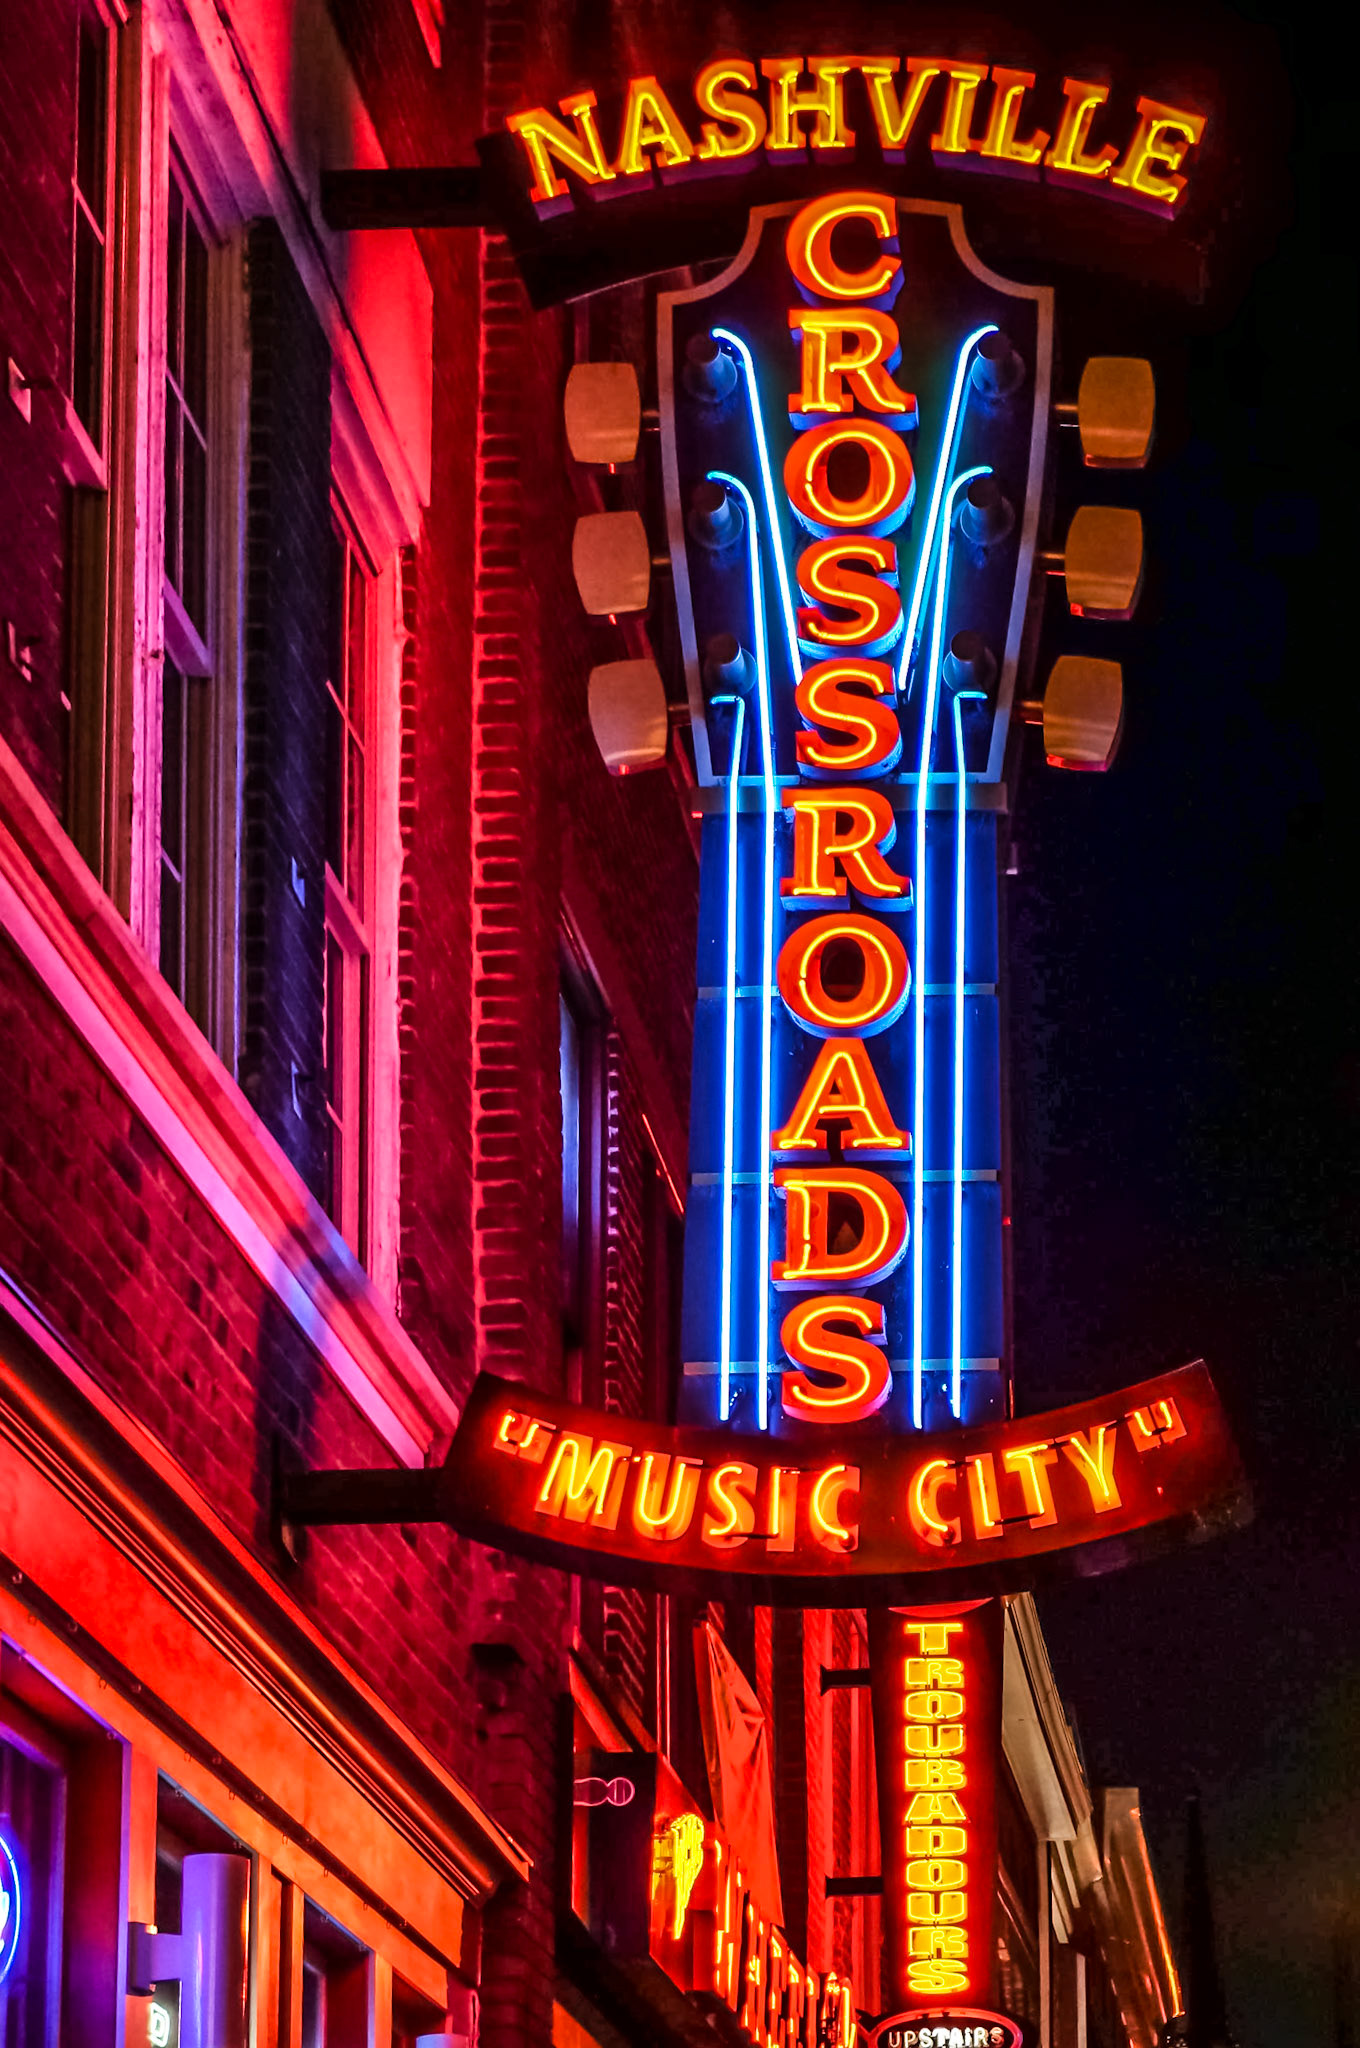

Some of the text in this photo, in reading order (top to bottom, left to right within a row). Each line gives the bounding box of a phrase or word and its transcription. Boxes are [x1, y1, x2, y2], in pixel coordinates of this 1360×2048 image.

[505, 55, 1206, 204] NASHVILLE
[770, 191, 917, 1425] CROSSROADS
[903, 1622, 971, 1995] TROUBADOURS
